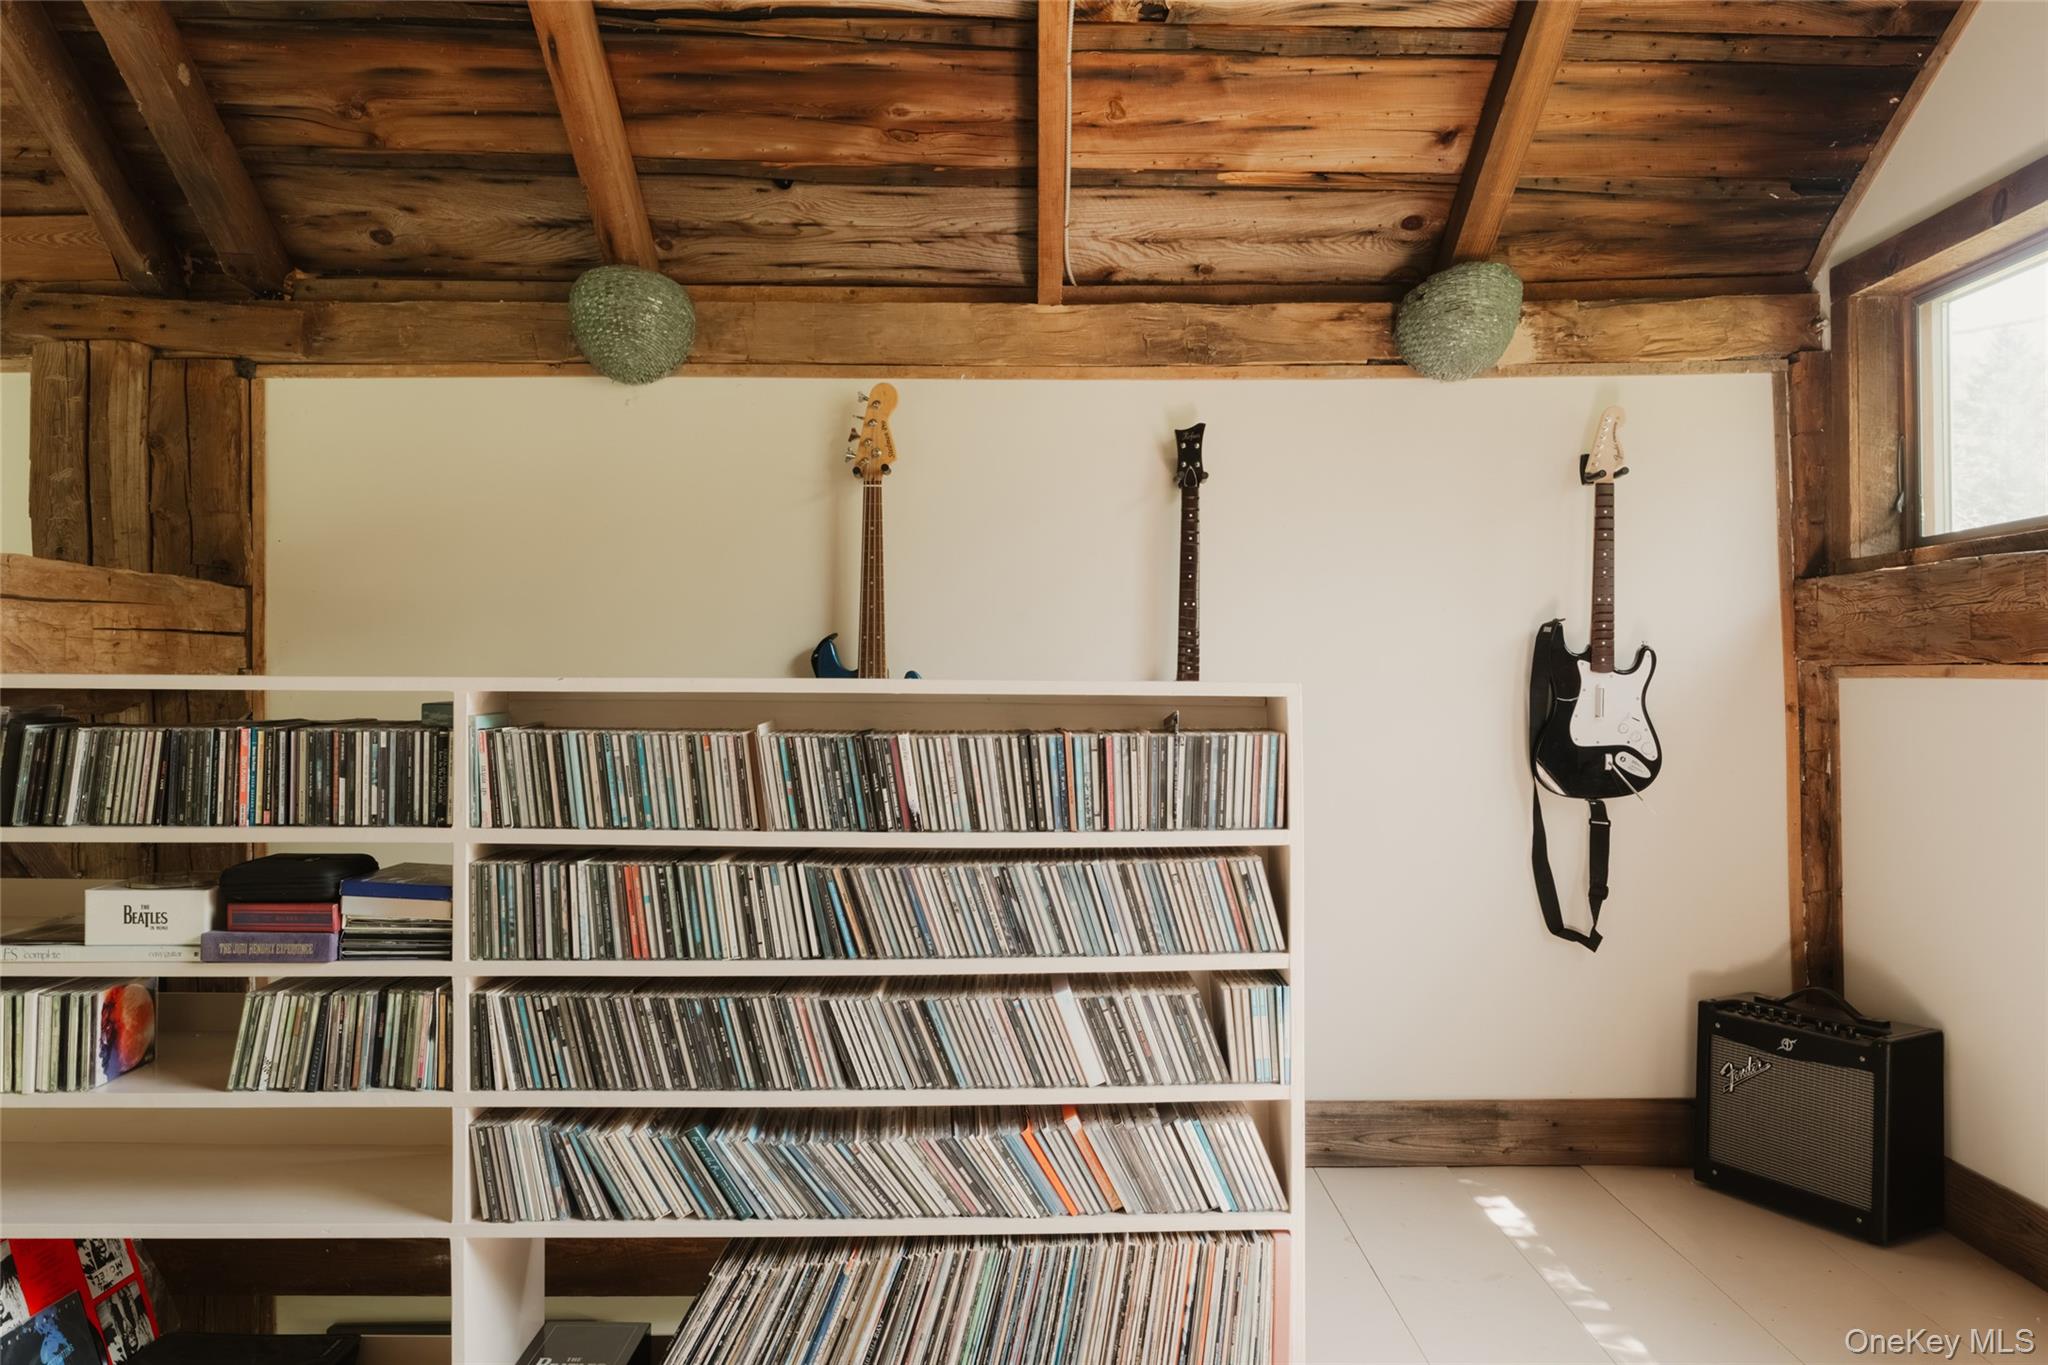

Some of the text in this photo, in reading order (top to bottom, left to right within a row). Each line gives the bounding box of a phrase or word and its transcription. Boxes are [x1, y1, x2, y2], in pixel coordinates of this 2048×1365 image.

[123, 905, 168, 927] BEATLES
[23, 948, 61, 960] complete
[1720, 1056, 1773, 1094] Fender
